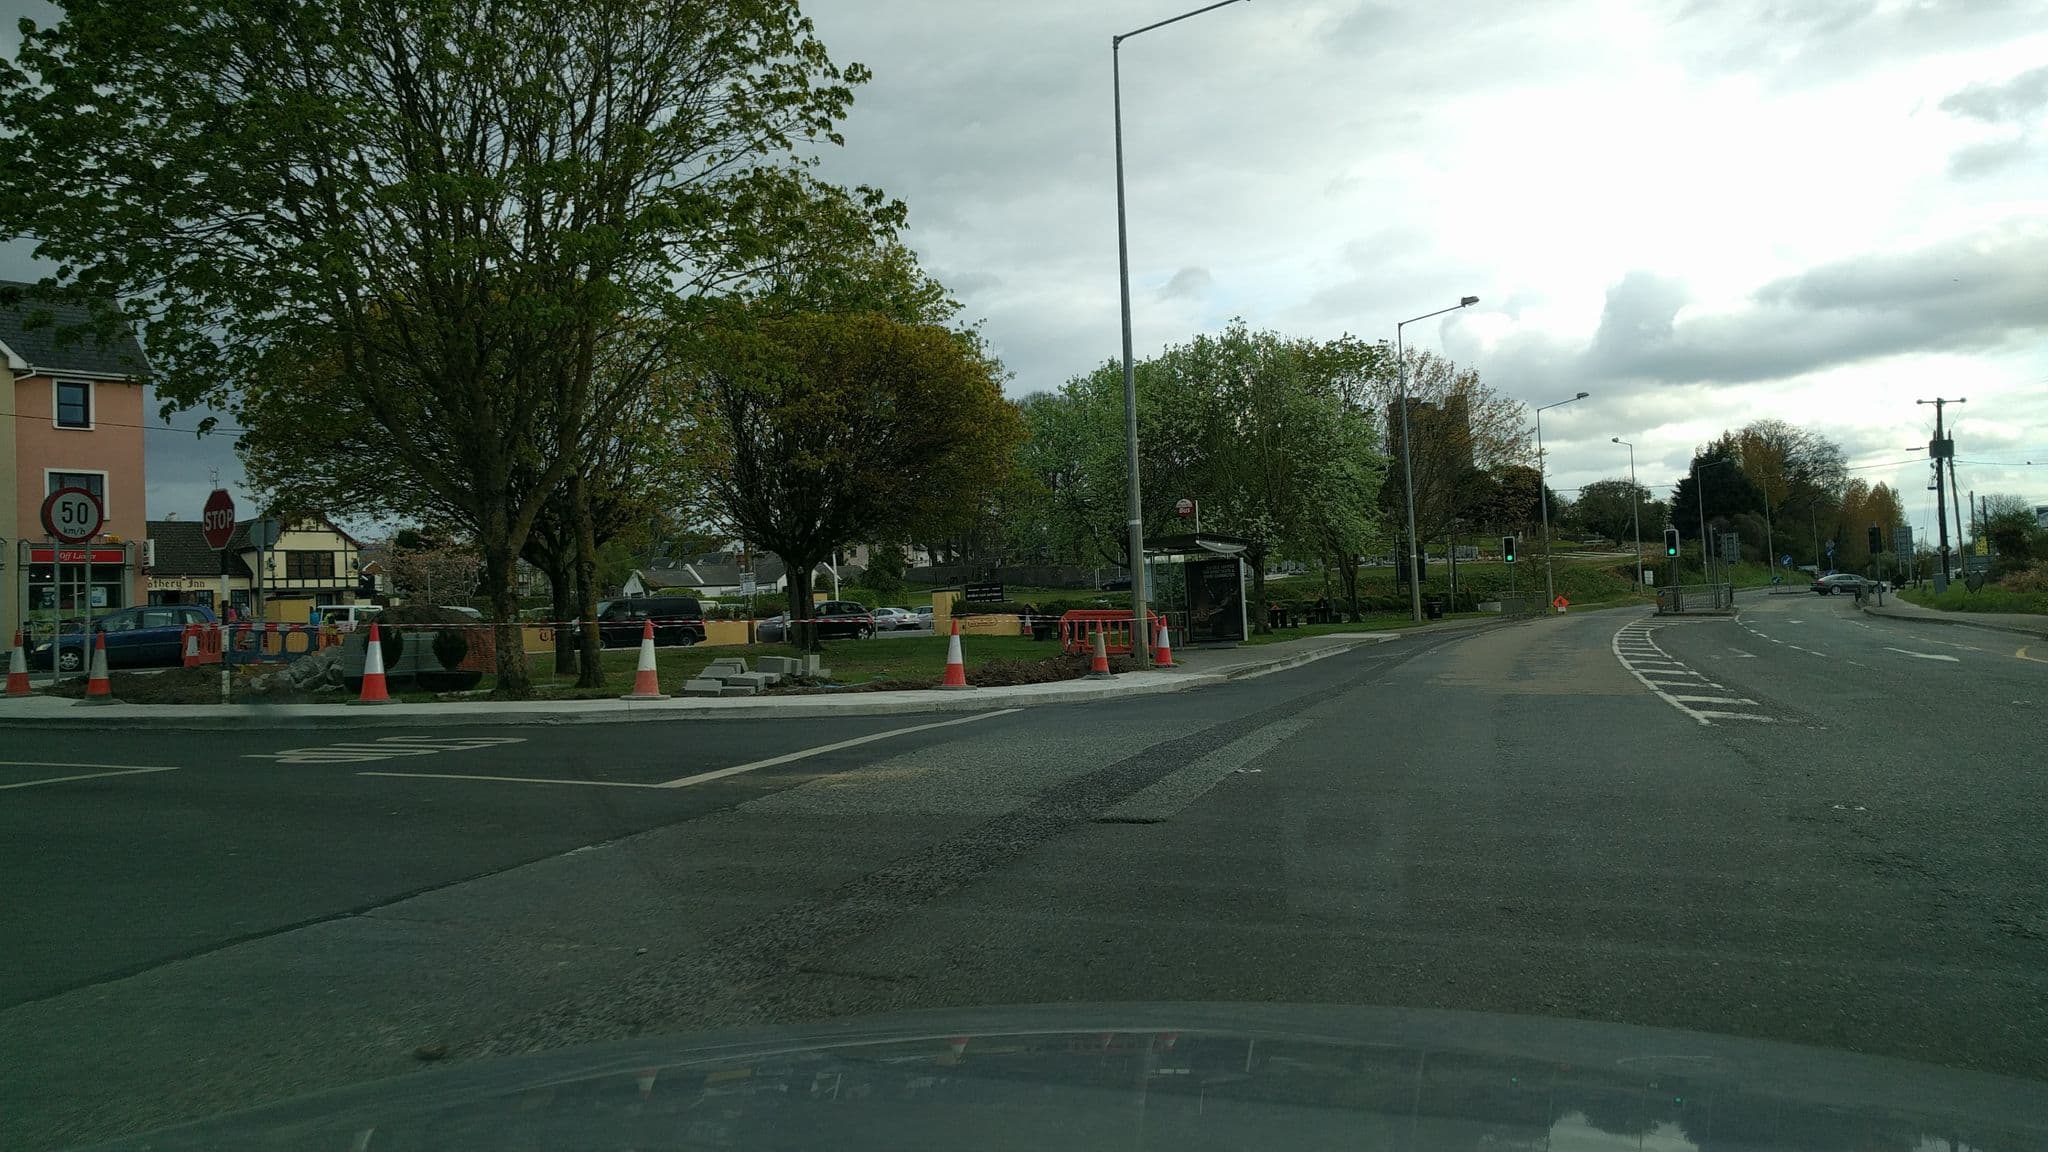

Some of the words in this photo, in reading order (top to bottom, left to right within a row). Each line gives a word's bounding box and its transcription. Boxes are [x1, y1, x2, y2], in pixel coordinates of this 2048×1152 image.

[62, 501, 88, 525] 50
[205, 508, 234, 531] STOP
[63, 527, 86, 536] km/h
